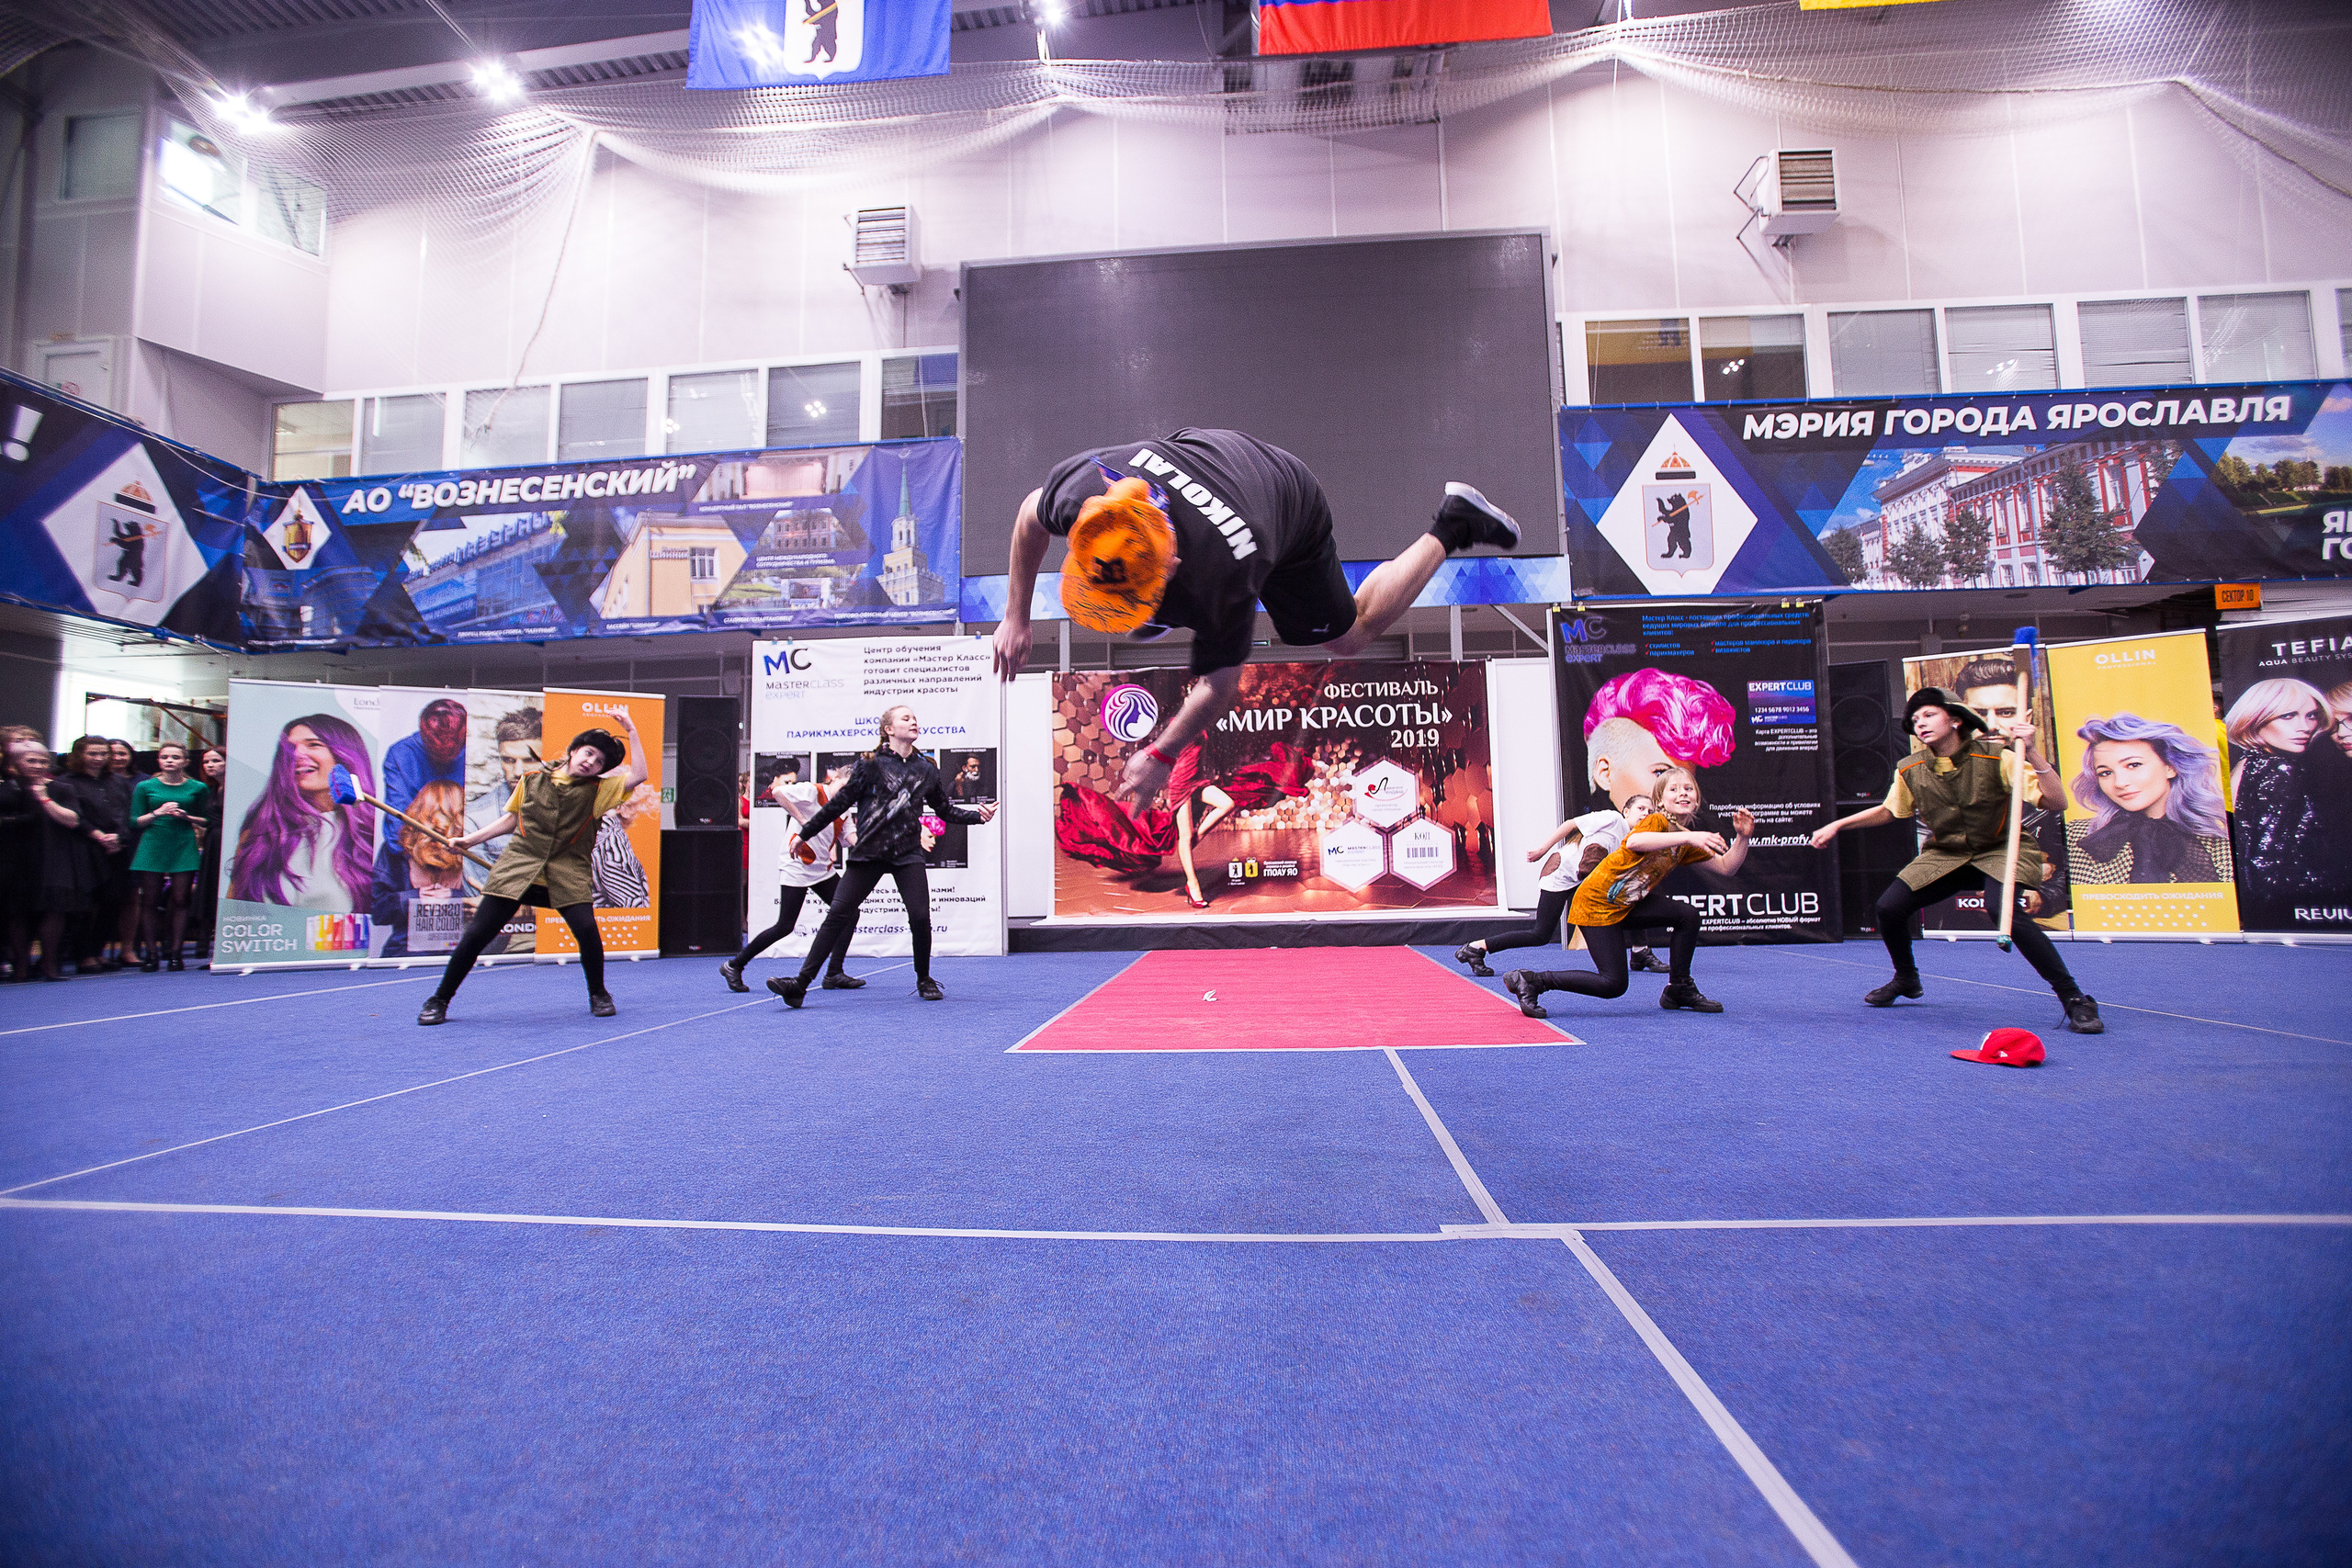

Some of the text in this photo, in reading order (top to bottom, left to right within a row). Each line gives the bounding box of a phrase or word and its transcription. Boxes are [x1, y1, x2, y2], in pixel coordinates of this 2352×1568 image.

[1743, 396, 2292, 440] МЭРИЯ ГОРОДА ЯРОСЛАВЛЯ
[342, 489, 392, 514] АО
[1128, 448, 1258, 560] NIKOLAI
[2222, 589, 2254, 603] СЕКТОР 10
[864, 645, 941, 654] Центр обучения
[2271, 636, 2352, 657] TEFIA
[763, 648, 812, 675] MC
[2095, 649, 2155, 665] OLLIN
[2258, 659, 2288, 667] AQUA
[2291, 654, 2331, 664] BEAUTY
[903, 665, 970, 673] специалистов
[919, 674, 982, 683] направлений
[917, 686, 958, 694] красоты
[1324, 681, 1439, 699] ФЕСТИВАЛЬ
[354, 697, 379, 705] Lond
[854, 716, 880, 725] ШКО
[1216, 702, 1453, 733] «МИР КРАСОТЫ»
[786, 728, 880, 739] ПАРИКМАХЕРСКО
[1391, 728, 1440, 748] 2019
[1751, 809, 1780, 818] рограмме
[1414, 832, 1430, 840] КОД
[1730, 833, 1812, 847] ww.mk-profy.
[2081, 892, 2223, 901] ПРЕВОСХОДИТЬ ОЖИДАНИЯ
[416, 917, 460, 931] HAIR COLOR
[545, 914, 651, 924] ПРЕВТЬ ОЖИДАНИЯ
[221, 924, 283, 938] COLOR
[500, 922, 537, 934] OND
[221, 939, 298, 953] SWITCH
